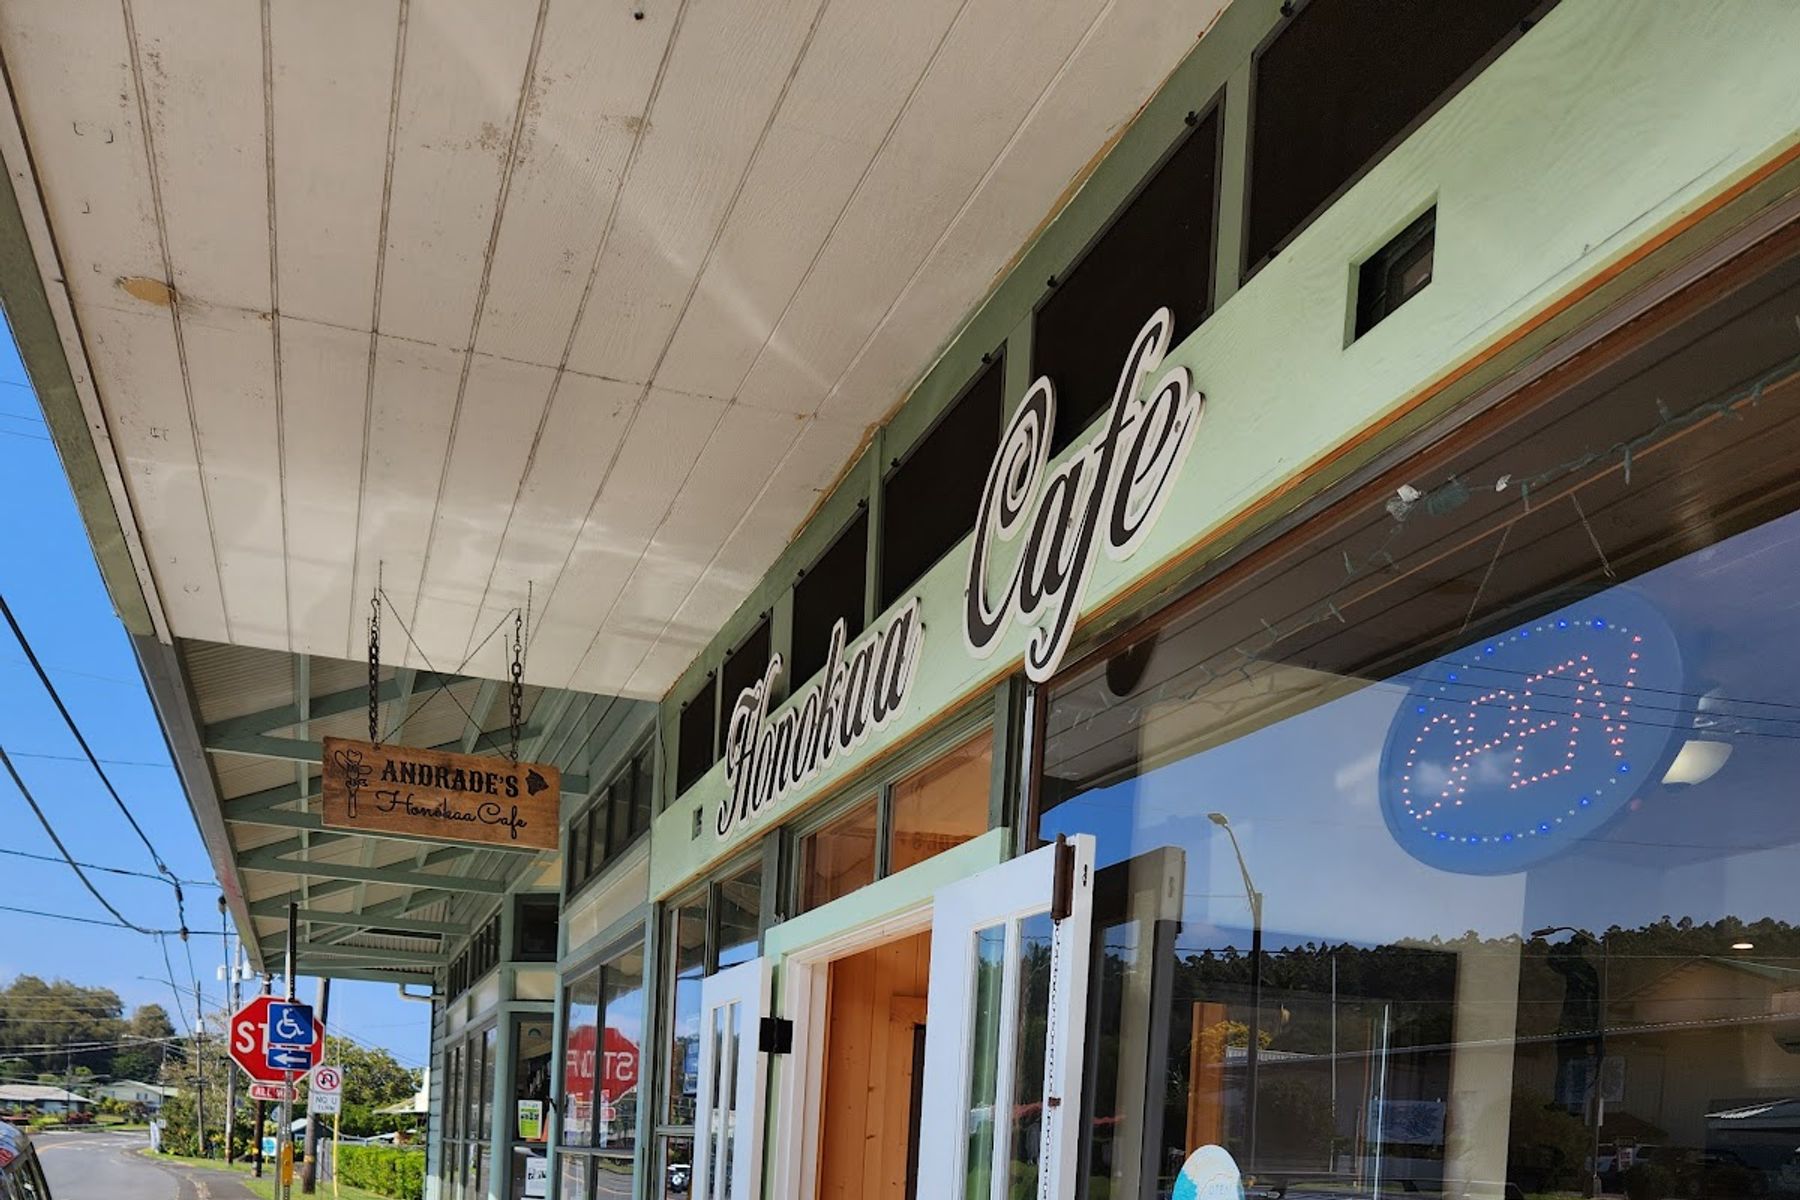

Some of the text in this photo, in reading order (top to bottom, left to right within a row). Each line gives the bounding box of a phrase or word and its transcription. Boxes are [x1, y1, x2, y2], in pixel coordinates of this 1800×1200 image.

[716, 307, 1204, 838] Honokaa Cafe
[380, 759, 519, 798] ANDRADE'S
[1402, 634, 1642, 821] OPEN
[375, 790, 528, 840] Honokaa Cafe
